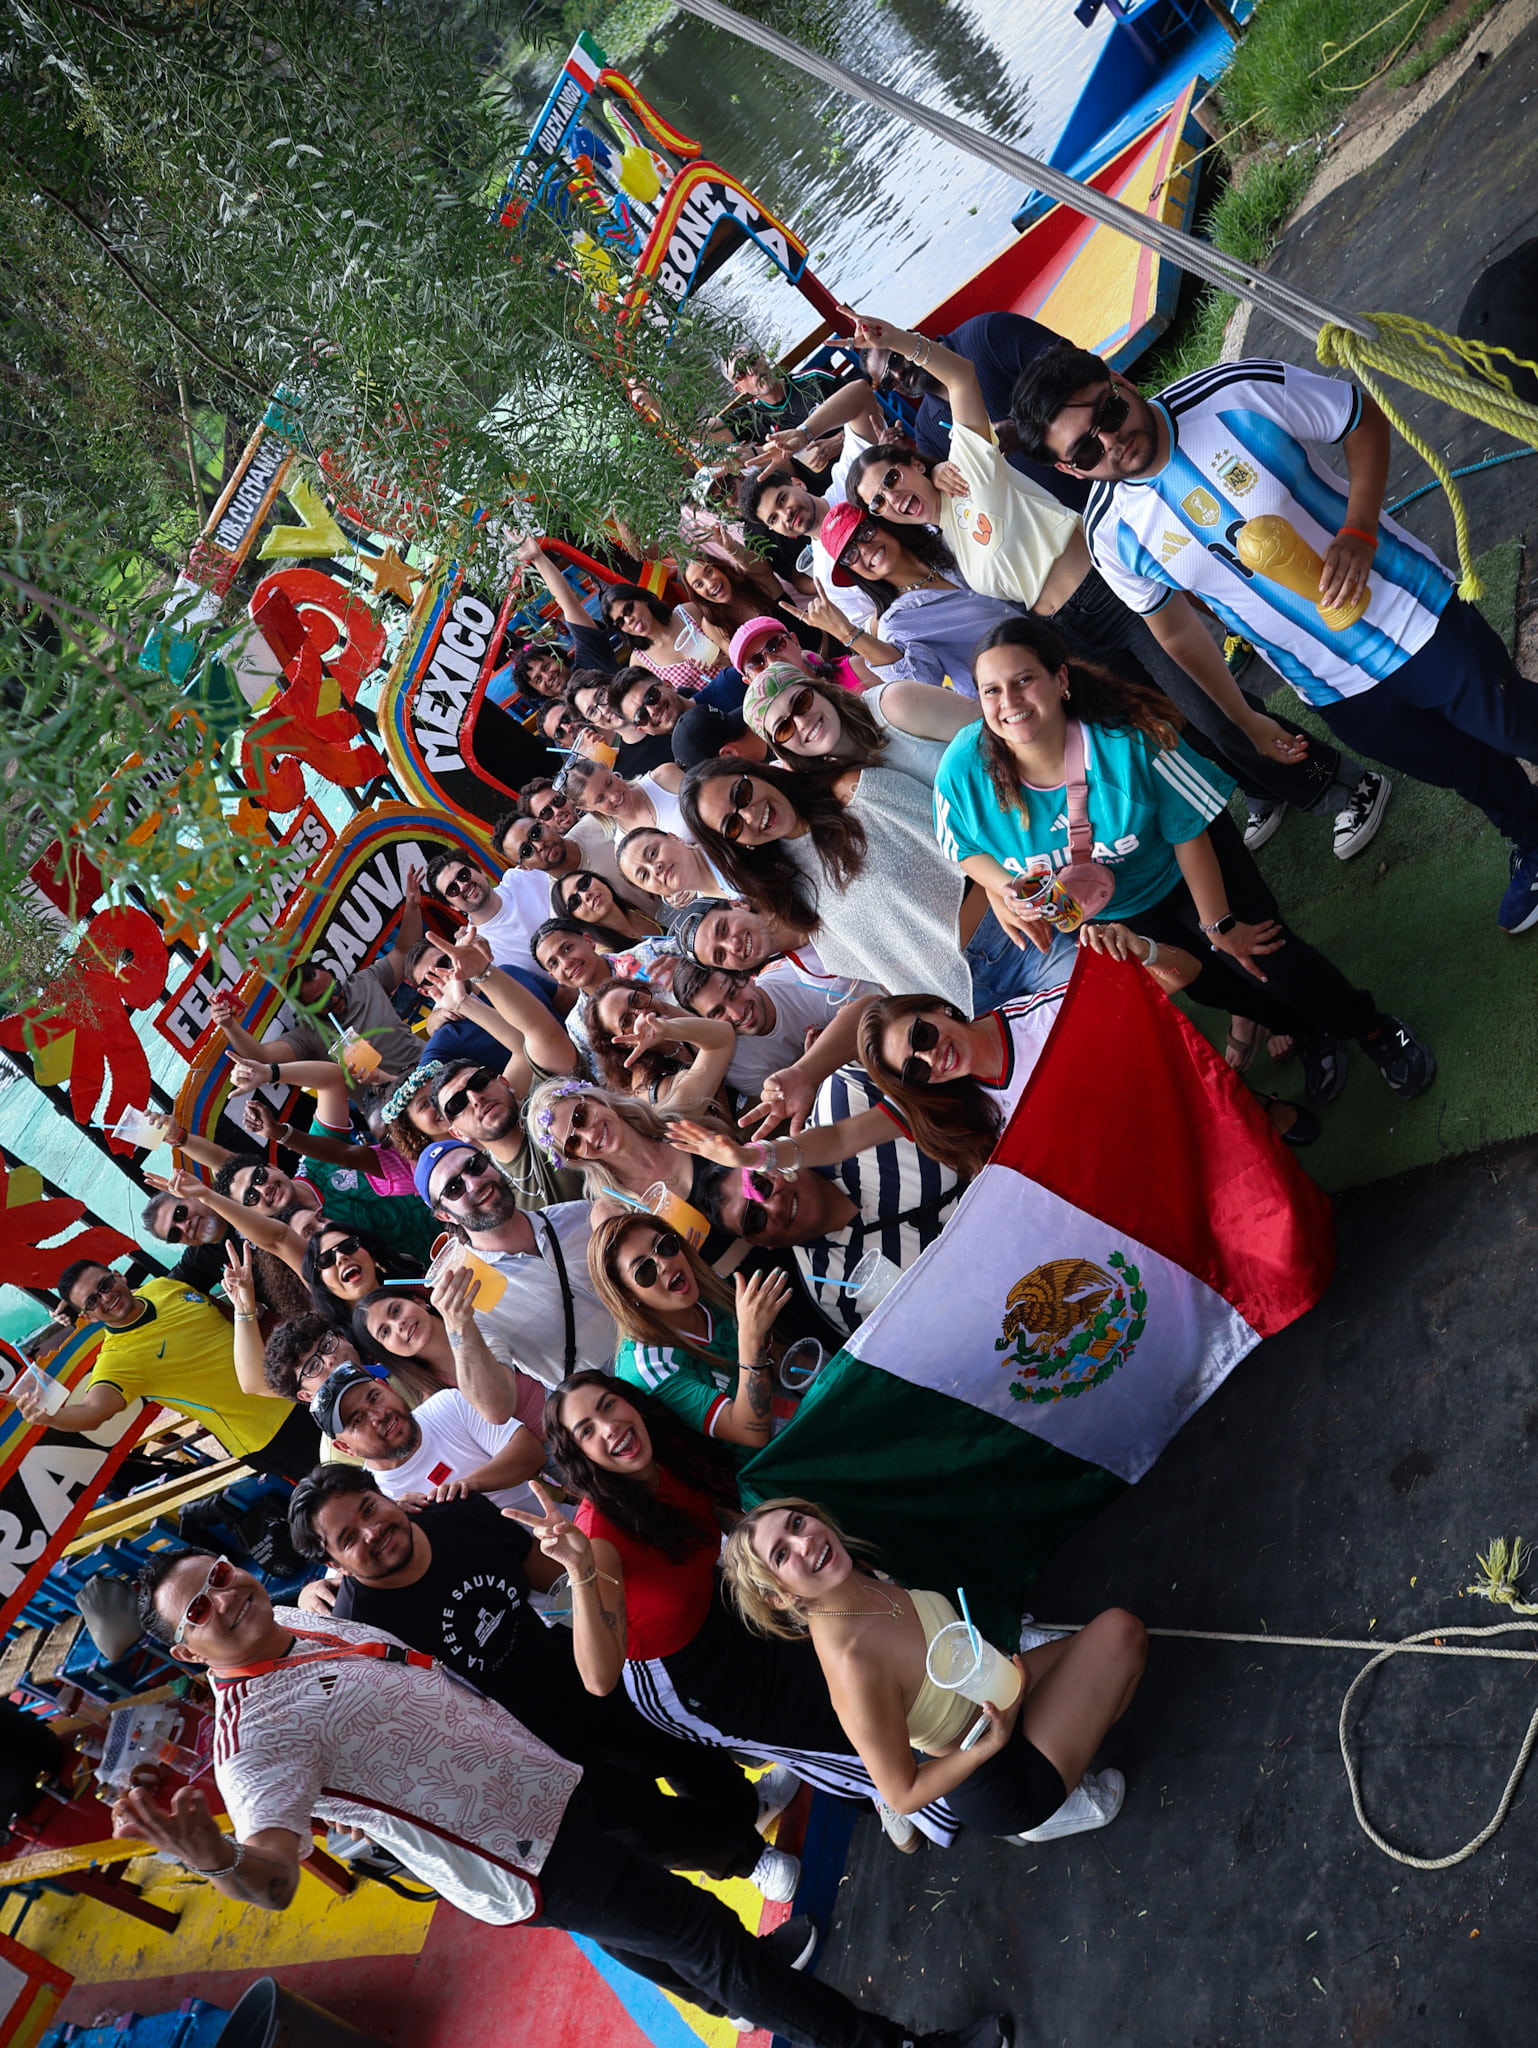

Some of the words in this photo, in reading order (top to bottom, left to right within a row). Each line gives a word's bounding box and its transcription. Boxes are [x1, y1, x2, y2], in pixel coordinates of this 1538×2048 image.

[657, 182, 790, 302] BONITA
[451, 1574, 521, 1611] SAUVAGE
[467, 1654, 484, 1672] LA
